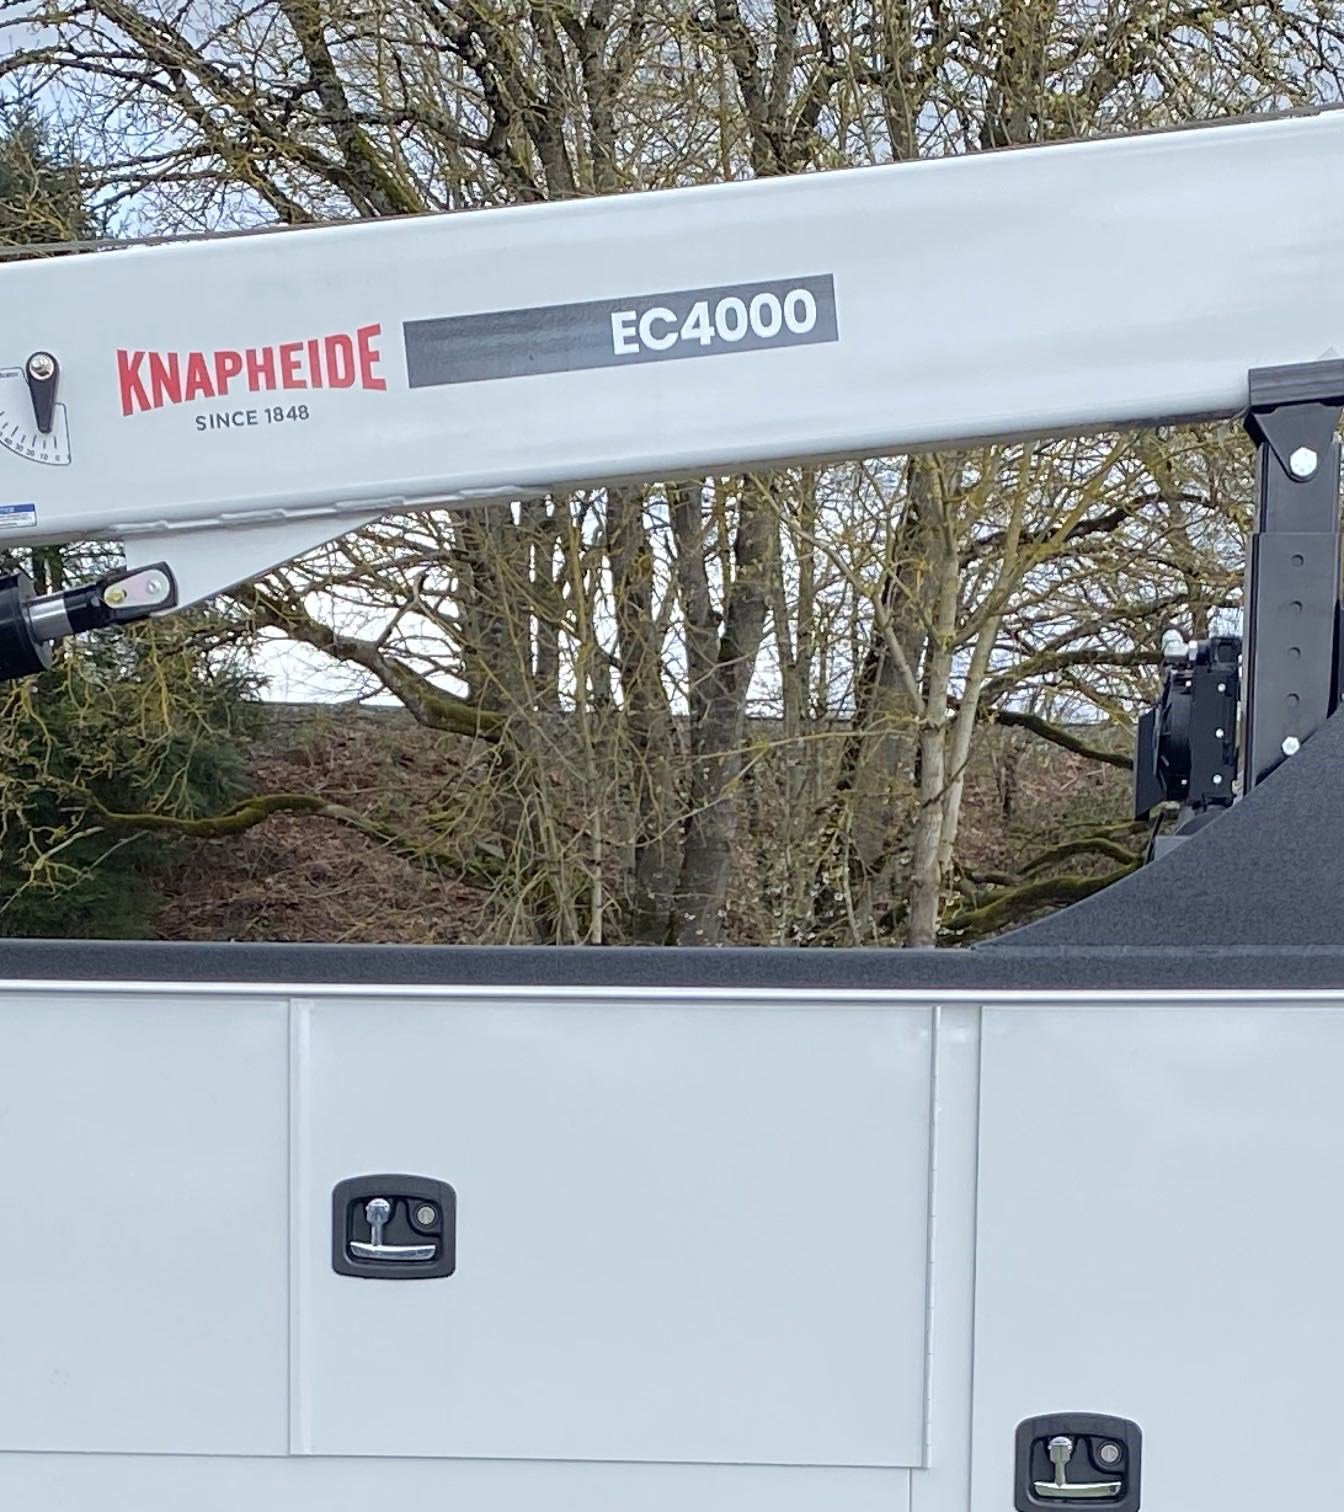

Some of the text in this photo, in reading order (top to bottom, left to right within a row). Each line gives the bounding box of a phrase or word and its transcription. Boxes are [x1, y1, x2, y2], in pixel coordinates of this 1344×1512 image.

[610, 288, 817, 356] EC4000
[116, 323, 387, 416] KNAPHEIDE
[195, 404, 310, 431] SINCE 1848
